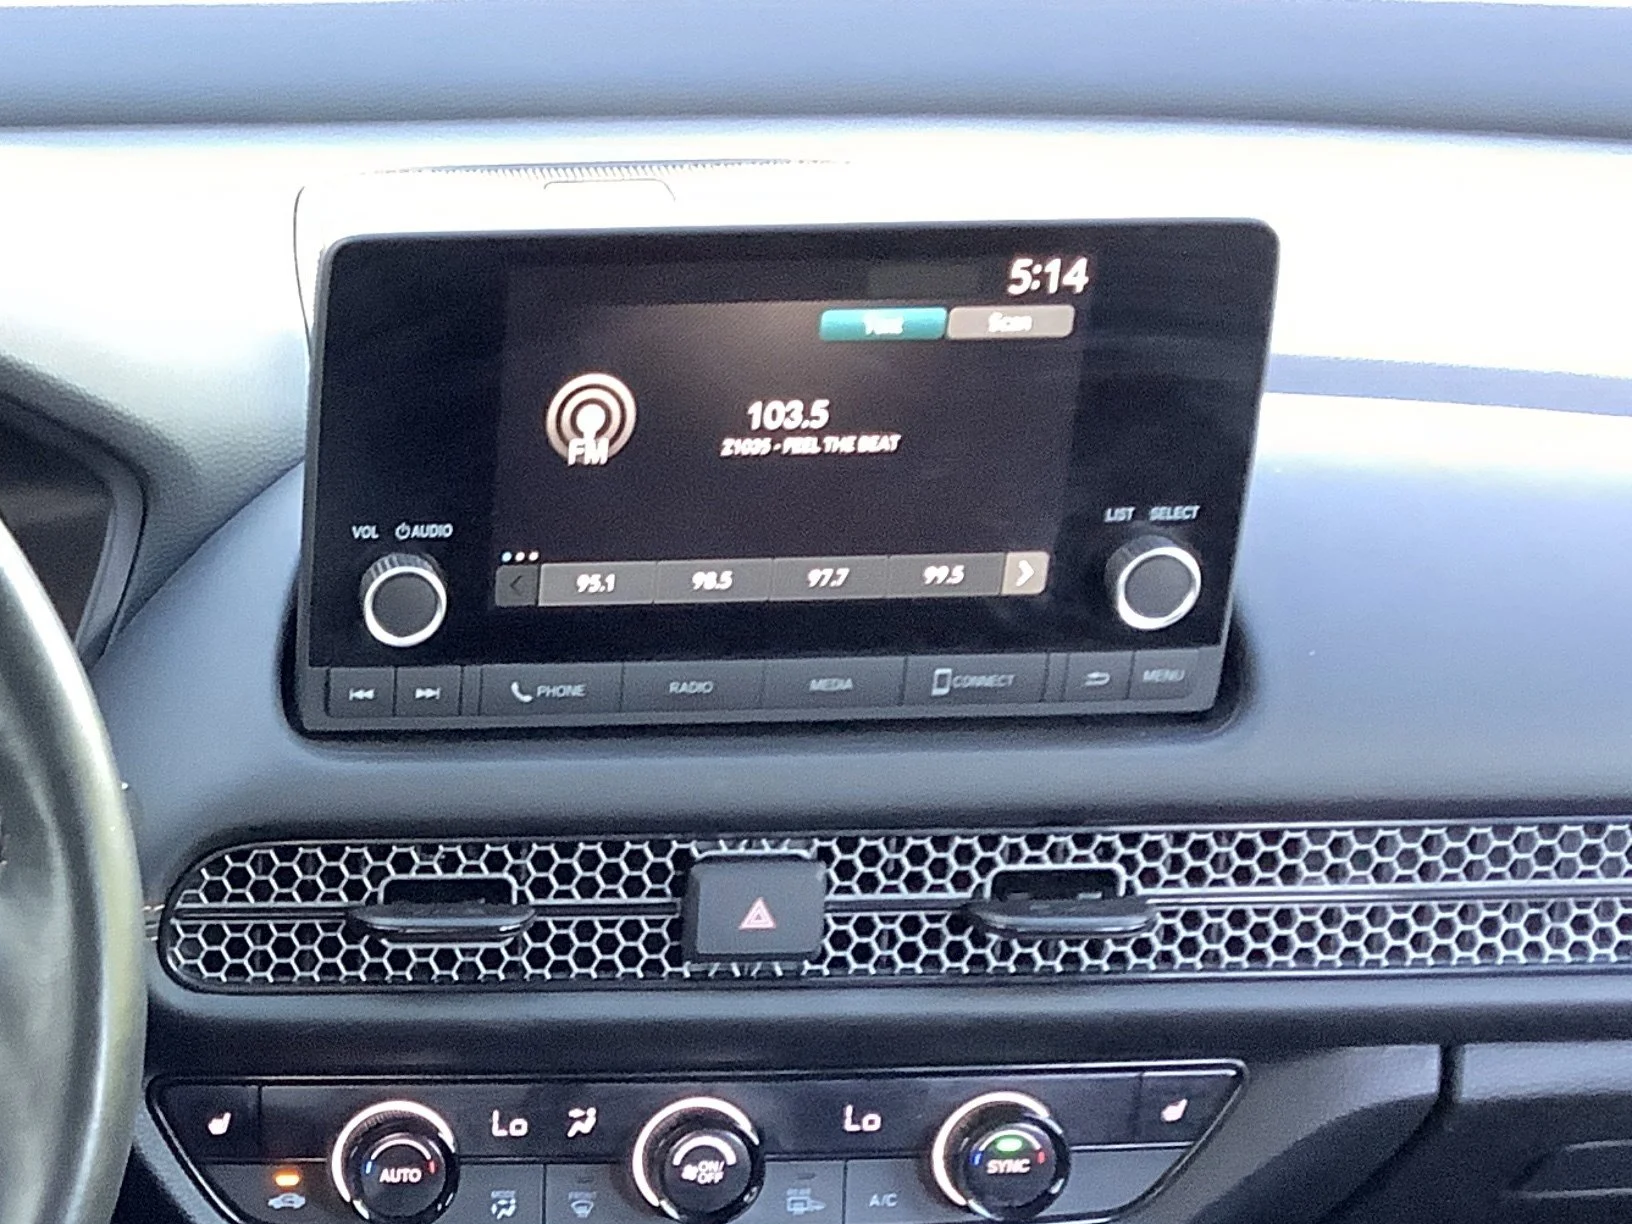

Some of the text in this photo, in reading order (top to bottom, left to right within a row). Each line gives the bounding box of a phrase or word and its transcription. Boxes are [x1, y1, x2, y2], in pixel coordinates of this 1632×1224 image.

[1008, 256, 1089, 295] 5:14
[747, 399, 830, 431] 103.5
[568, 437, 609, 466] FM
[782, 436, 821, 455] FEEL
[822, 435, 857, 453] THE
[857, 433, 902, 453] BEAT
[1104, 507, 1135, 523] LIST
[1149, 505, 1200, 521] SELECT
[352, 525, 380, 540] VOL
[411, 524, 453, 539] AUDIO
[806, 568, 849, 588] 97.7
[923, 565, 965, 585] 99.5
[576, 574, 616, 593] 95.1
[953, 674, 1016, 689] CONNECT
[1143, 669, 1186, 684] MENU
[536, 683, 586, 698] PHONE
[669, 681, 714, 695] RADIO
[809, 678, 854, 692] MEDIA
[697, 1161, 725, 1173] ON/
[986, 1159, 1031, 1175] SYNC
[378, 1168, 423, 1184] AUTO
[696, 1172, 724, 1185] OFF
[869, 1193, 898, 1207] A/C
